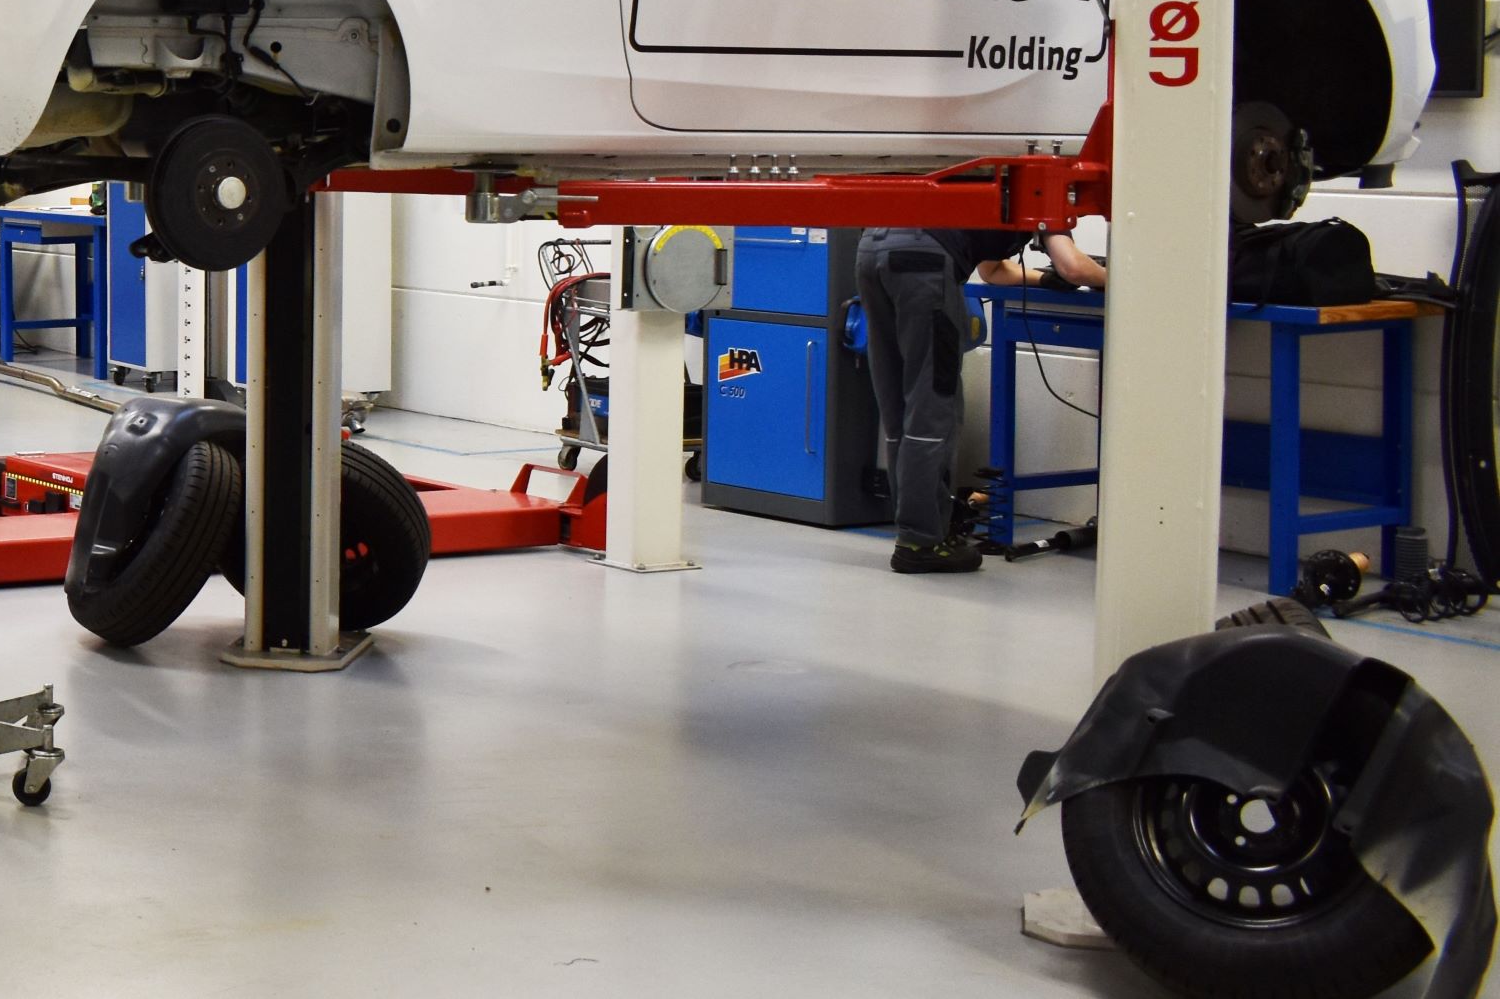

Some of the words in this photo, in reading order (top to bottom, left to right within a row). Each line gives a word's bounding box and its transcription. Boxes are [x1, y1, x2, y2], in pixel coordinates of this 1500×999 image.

[967, 35, 1082, 80] Kolding
[729, 348, 762, 372] HPA
[719, 384, 728, 397] C
